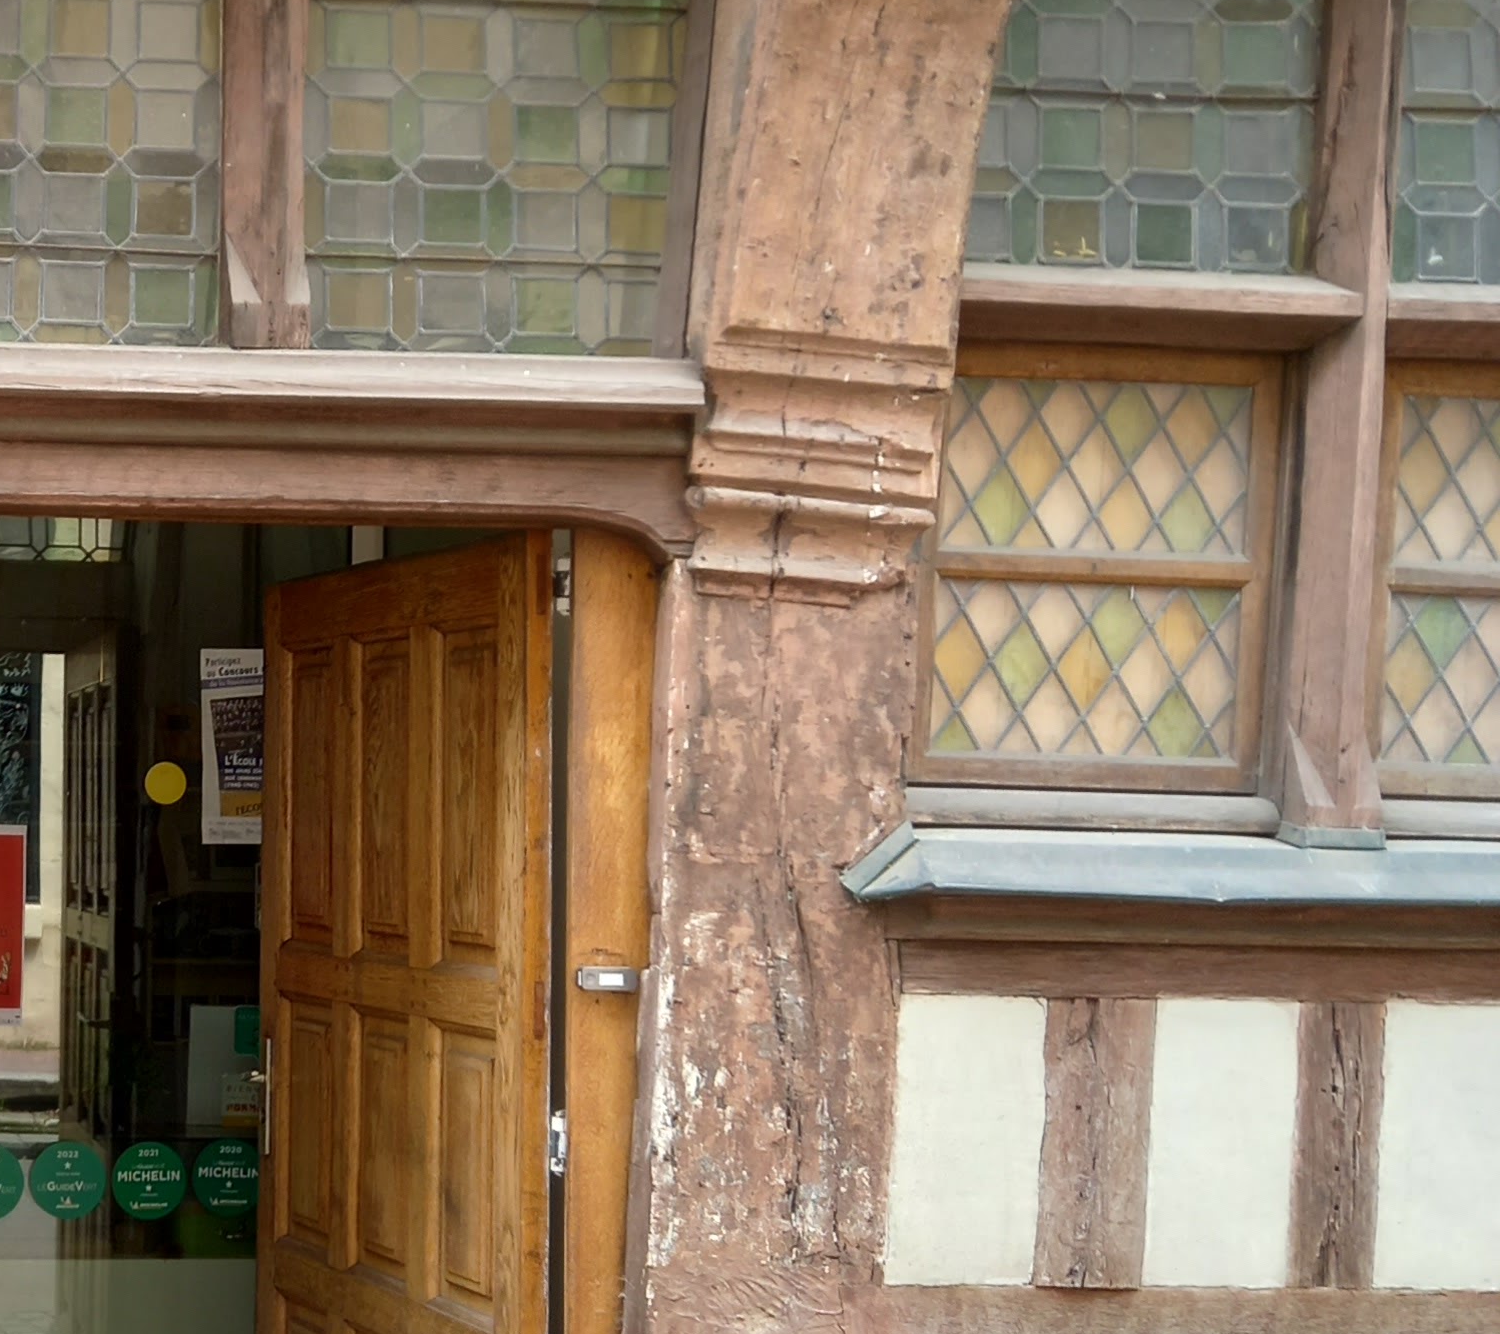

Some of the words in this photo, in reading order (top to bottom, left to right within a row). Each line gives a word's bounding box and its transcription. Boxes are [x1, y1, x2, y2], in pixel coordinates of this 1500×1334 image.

[218, 667, 259, 677] Concours
[138, 1148, 159, 1157] 2021
[219, 1145, 242, 1154] 2020
[57, 1150, 79, 1159] 2022
[117, 1169, 181, 1182] MICHELIN
